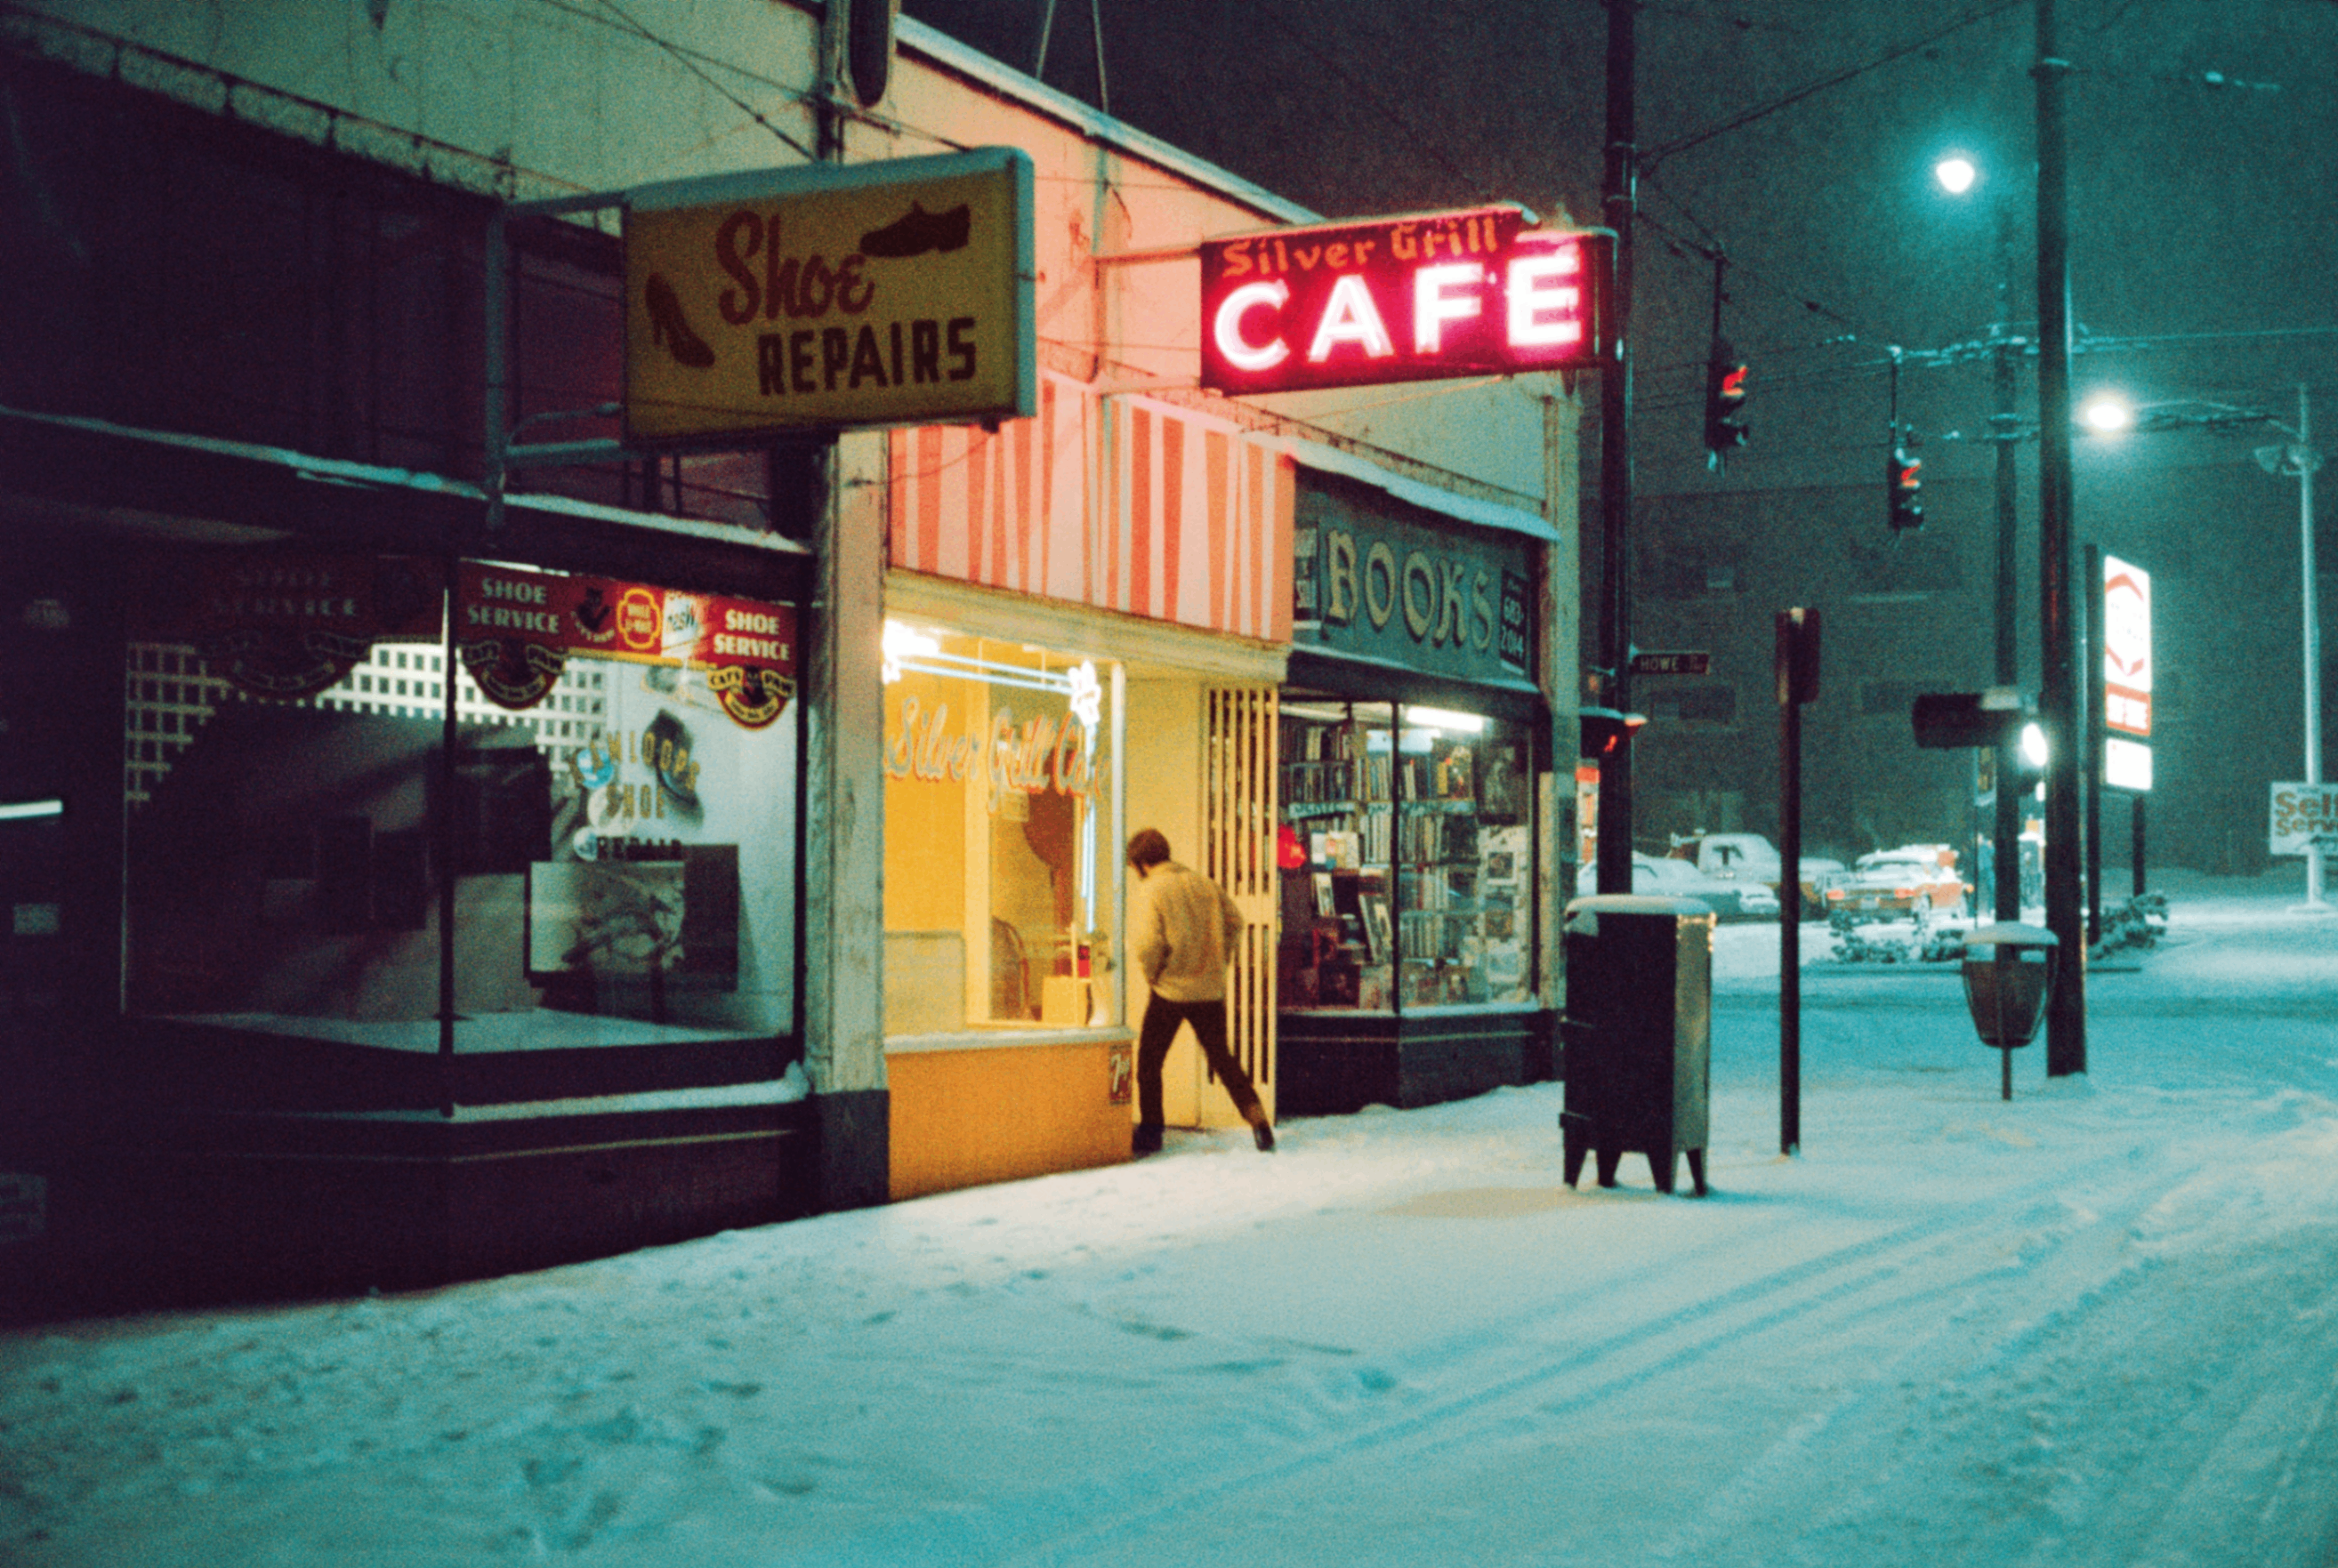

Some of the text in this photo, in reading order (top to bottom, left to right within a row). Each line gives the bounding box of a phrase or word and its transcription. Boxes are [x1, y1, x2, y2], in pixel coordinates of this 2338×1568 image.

[1222, 216, 1497, 277] Silver Grill
[716, 210, 875, 325] Shoe
[758, 317, 976, 396] REPAIRS
[482, 577, 547, 605] SHOE
[1327, 529, 1494, 650] BOOKS
[467, 604, 560, 634] SERVICE
[725, 608, 781, 636] SHOE
[713, 632, 789, 661] SERVICE
[1641, 655, 1679, 671] HOWE
[606, 783, 665, 819] SHOE
